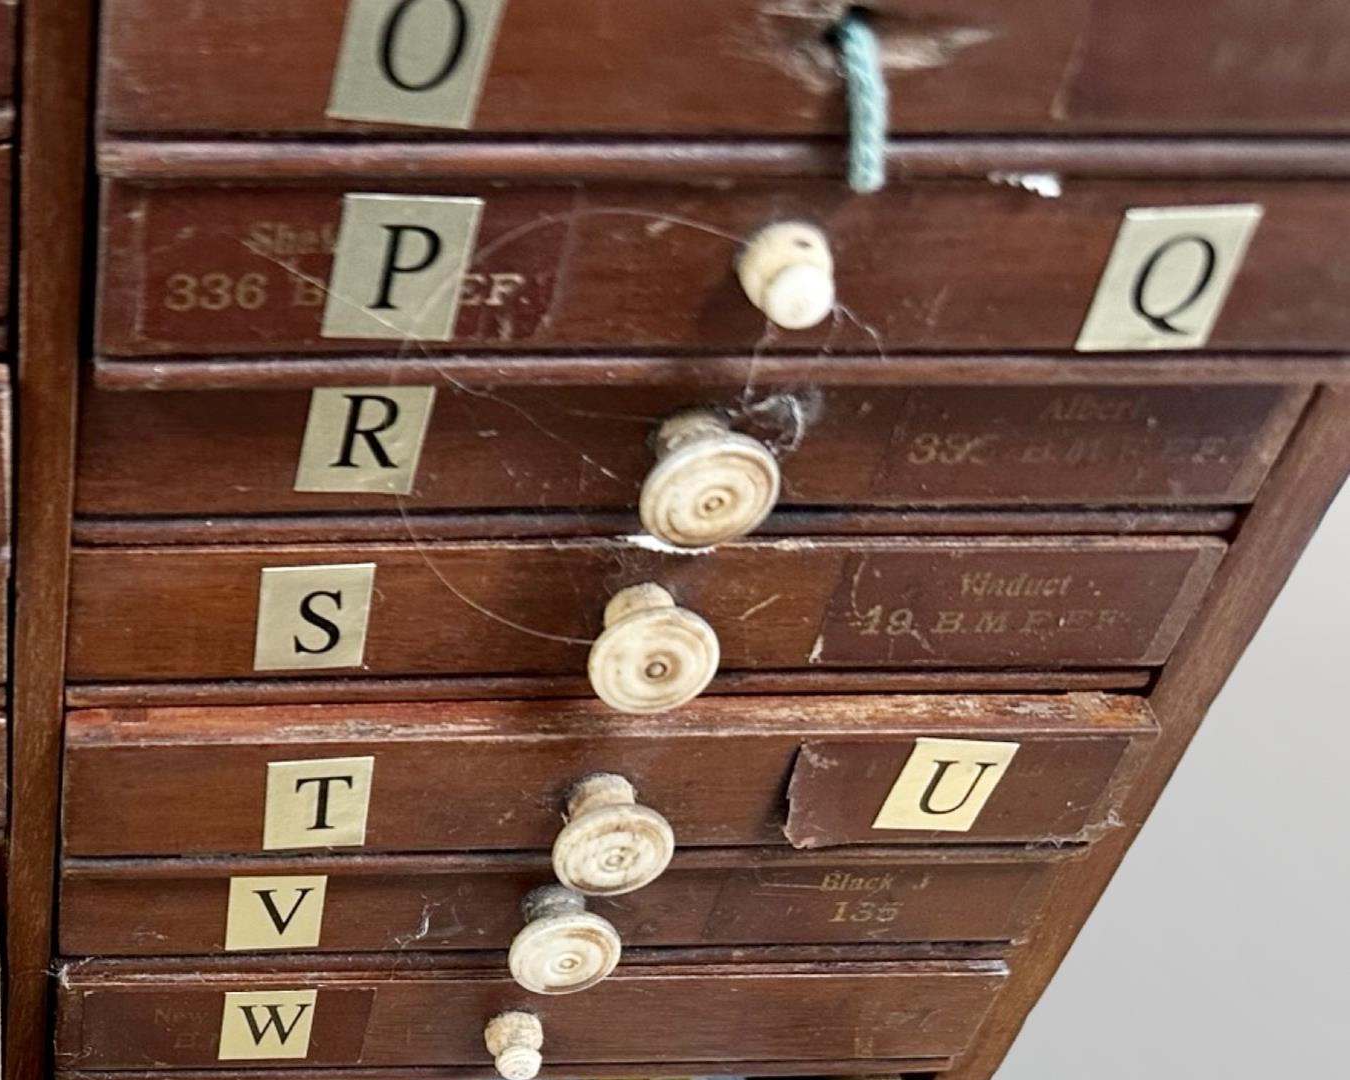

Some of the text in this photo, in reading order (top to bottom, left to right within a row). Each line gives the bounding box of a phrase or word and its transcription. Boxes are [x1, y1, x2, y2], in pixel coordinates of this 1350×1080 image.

[379, 0, 468, 92] O
[165, 273, 268, 312] 336
[367, 223, 441, 311] P
[1132, 233, 1216, 335] Q
[329, 394, 401, 469] R
[294, 590, 343, 656] S
[295, 775, 354, 831] T
[918, 759, 998, 815] U
[819, 872, 892, 894] Black
[253, 887, 314, 936] V
[828, 901, 904, 923] 135
[237, 1003, 312, 1046] W
